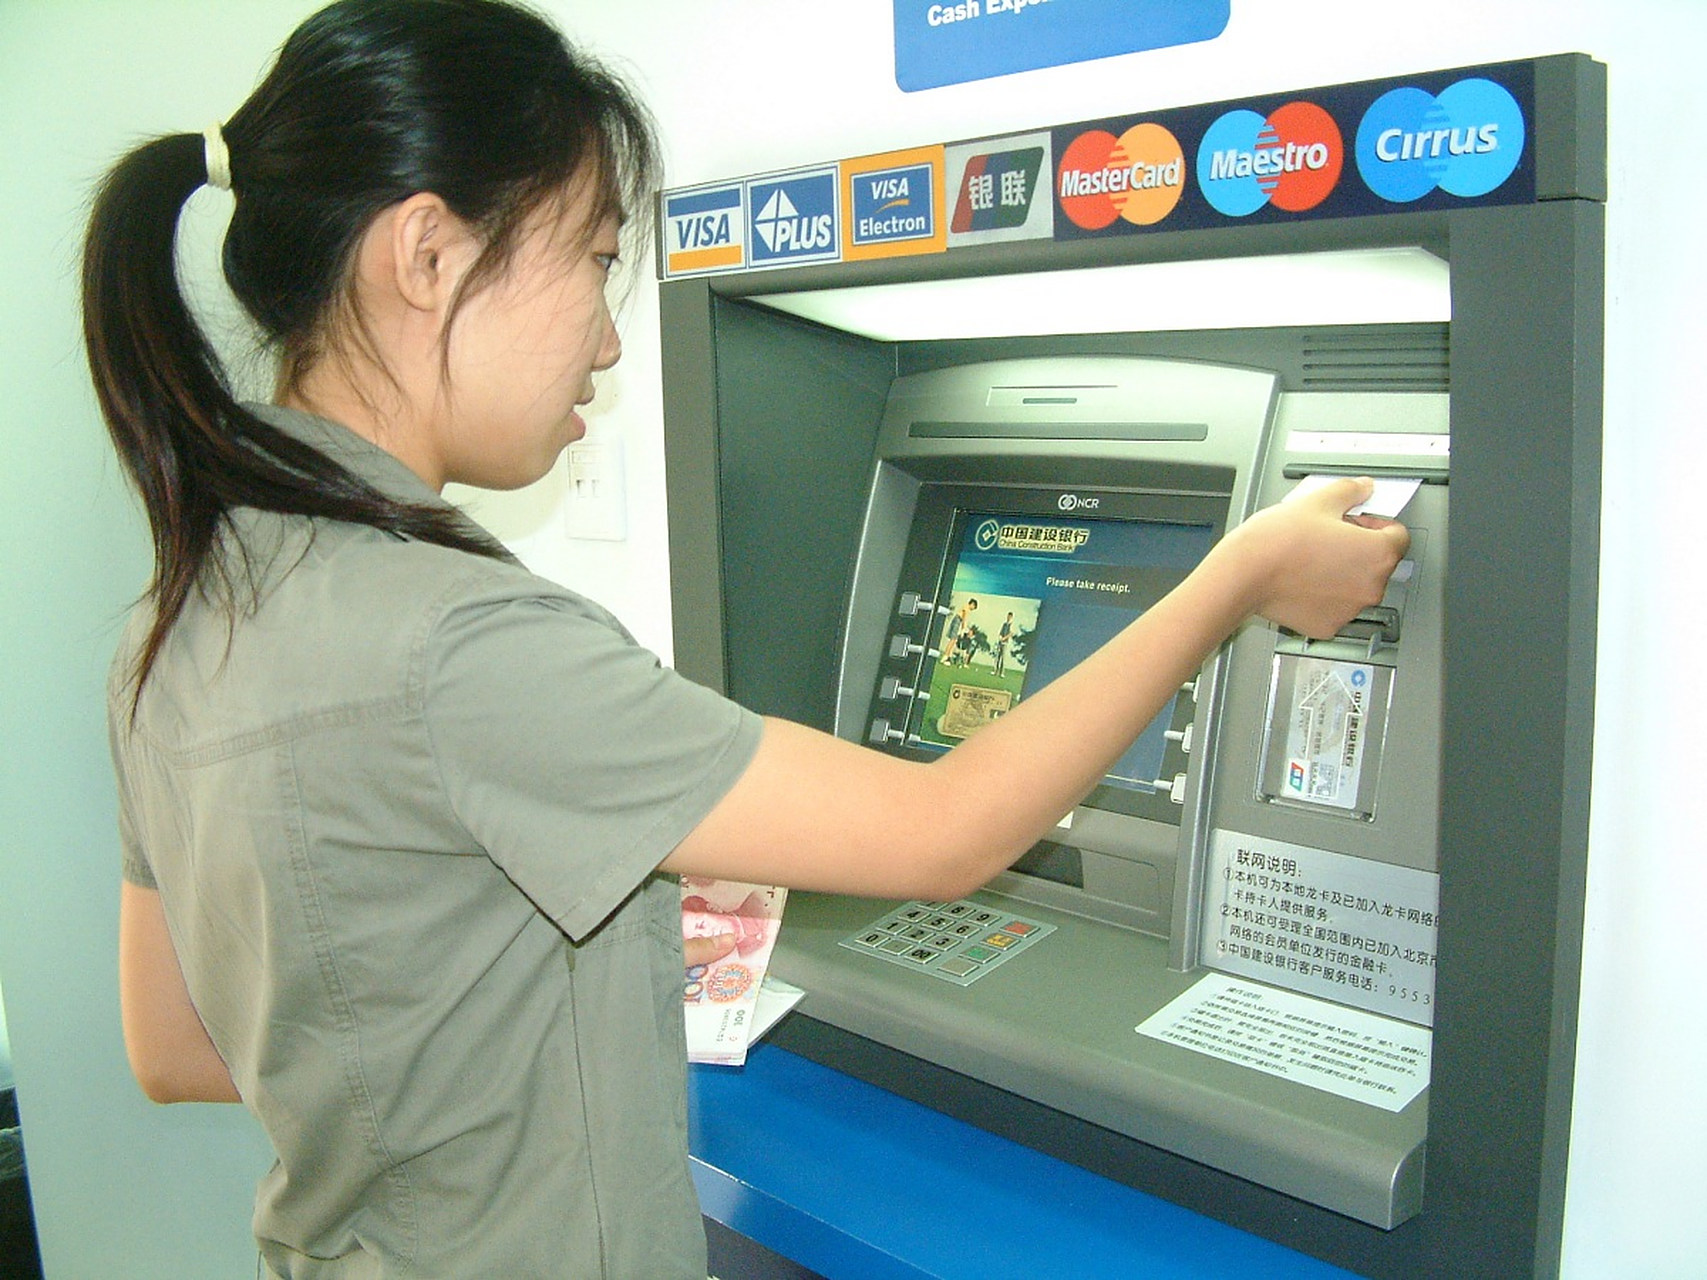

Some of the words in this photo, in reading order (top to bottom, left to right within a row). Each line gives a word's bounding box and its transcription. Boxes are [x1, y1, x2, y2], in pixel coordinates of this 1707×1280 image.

[927, 0, 980, 26] Cash
[1375, 123, 1498, 163] Cirrus
[1209, 142, 1328, 180] Maestro
[870, 177, 910, 200] VISA
[1060, 155, 1181, 199] MasterCard
[968, 170, 1027, 210] 银联
[676, 215, 731, 249] VISA
[775, 212, 832, 253] PLUS
[859, 213, 926, 237] Electron
[1077, 498, 1100, 509] NCR
[1001, 526, 1089, 544] 中国建设银行
[1018, 541, 1055, 549] Construction
[1057, 543, 1073, 551] Bank
[1046, 577, 1075, 588] Please
[1077, 580, 1095, 590] take
[1097, 582, 1131, 594] receipt.
[734, 1009, 746, 1026] 100
